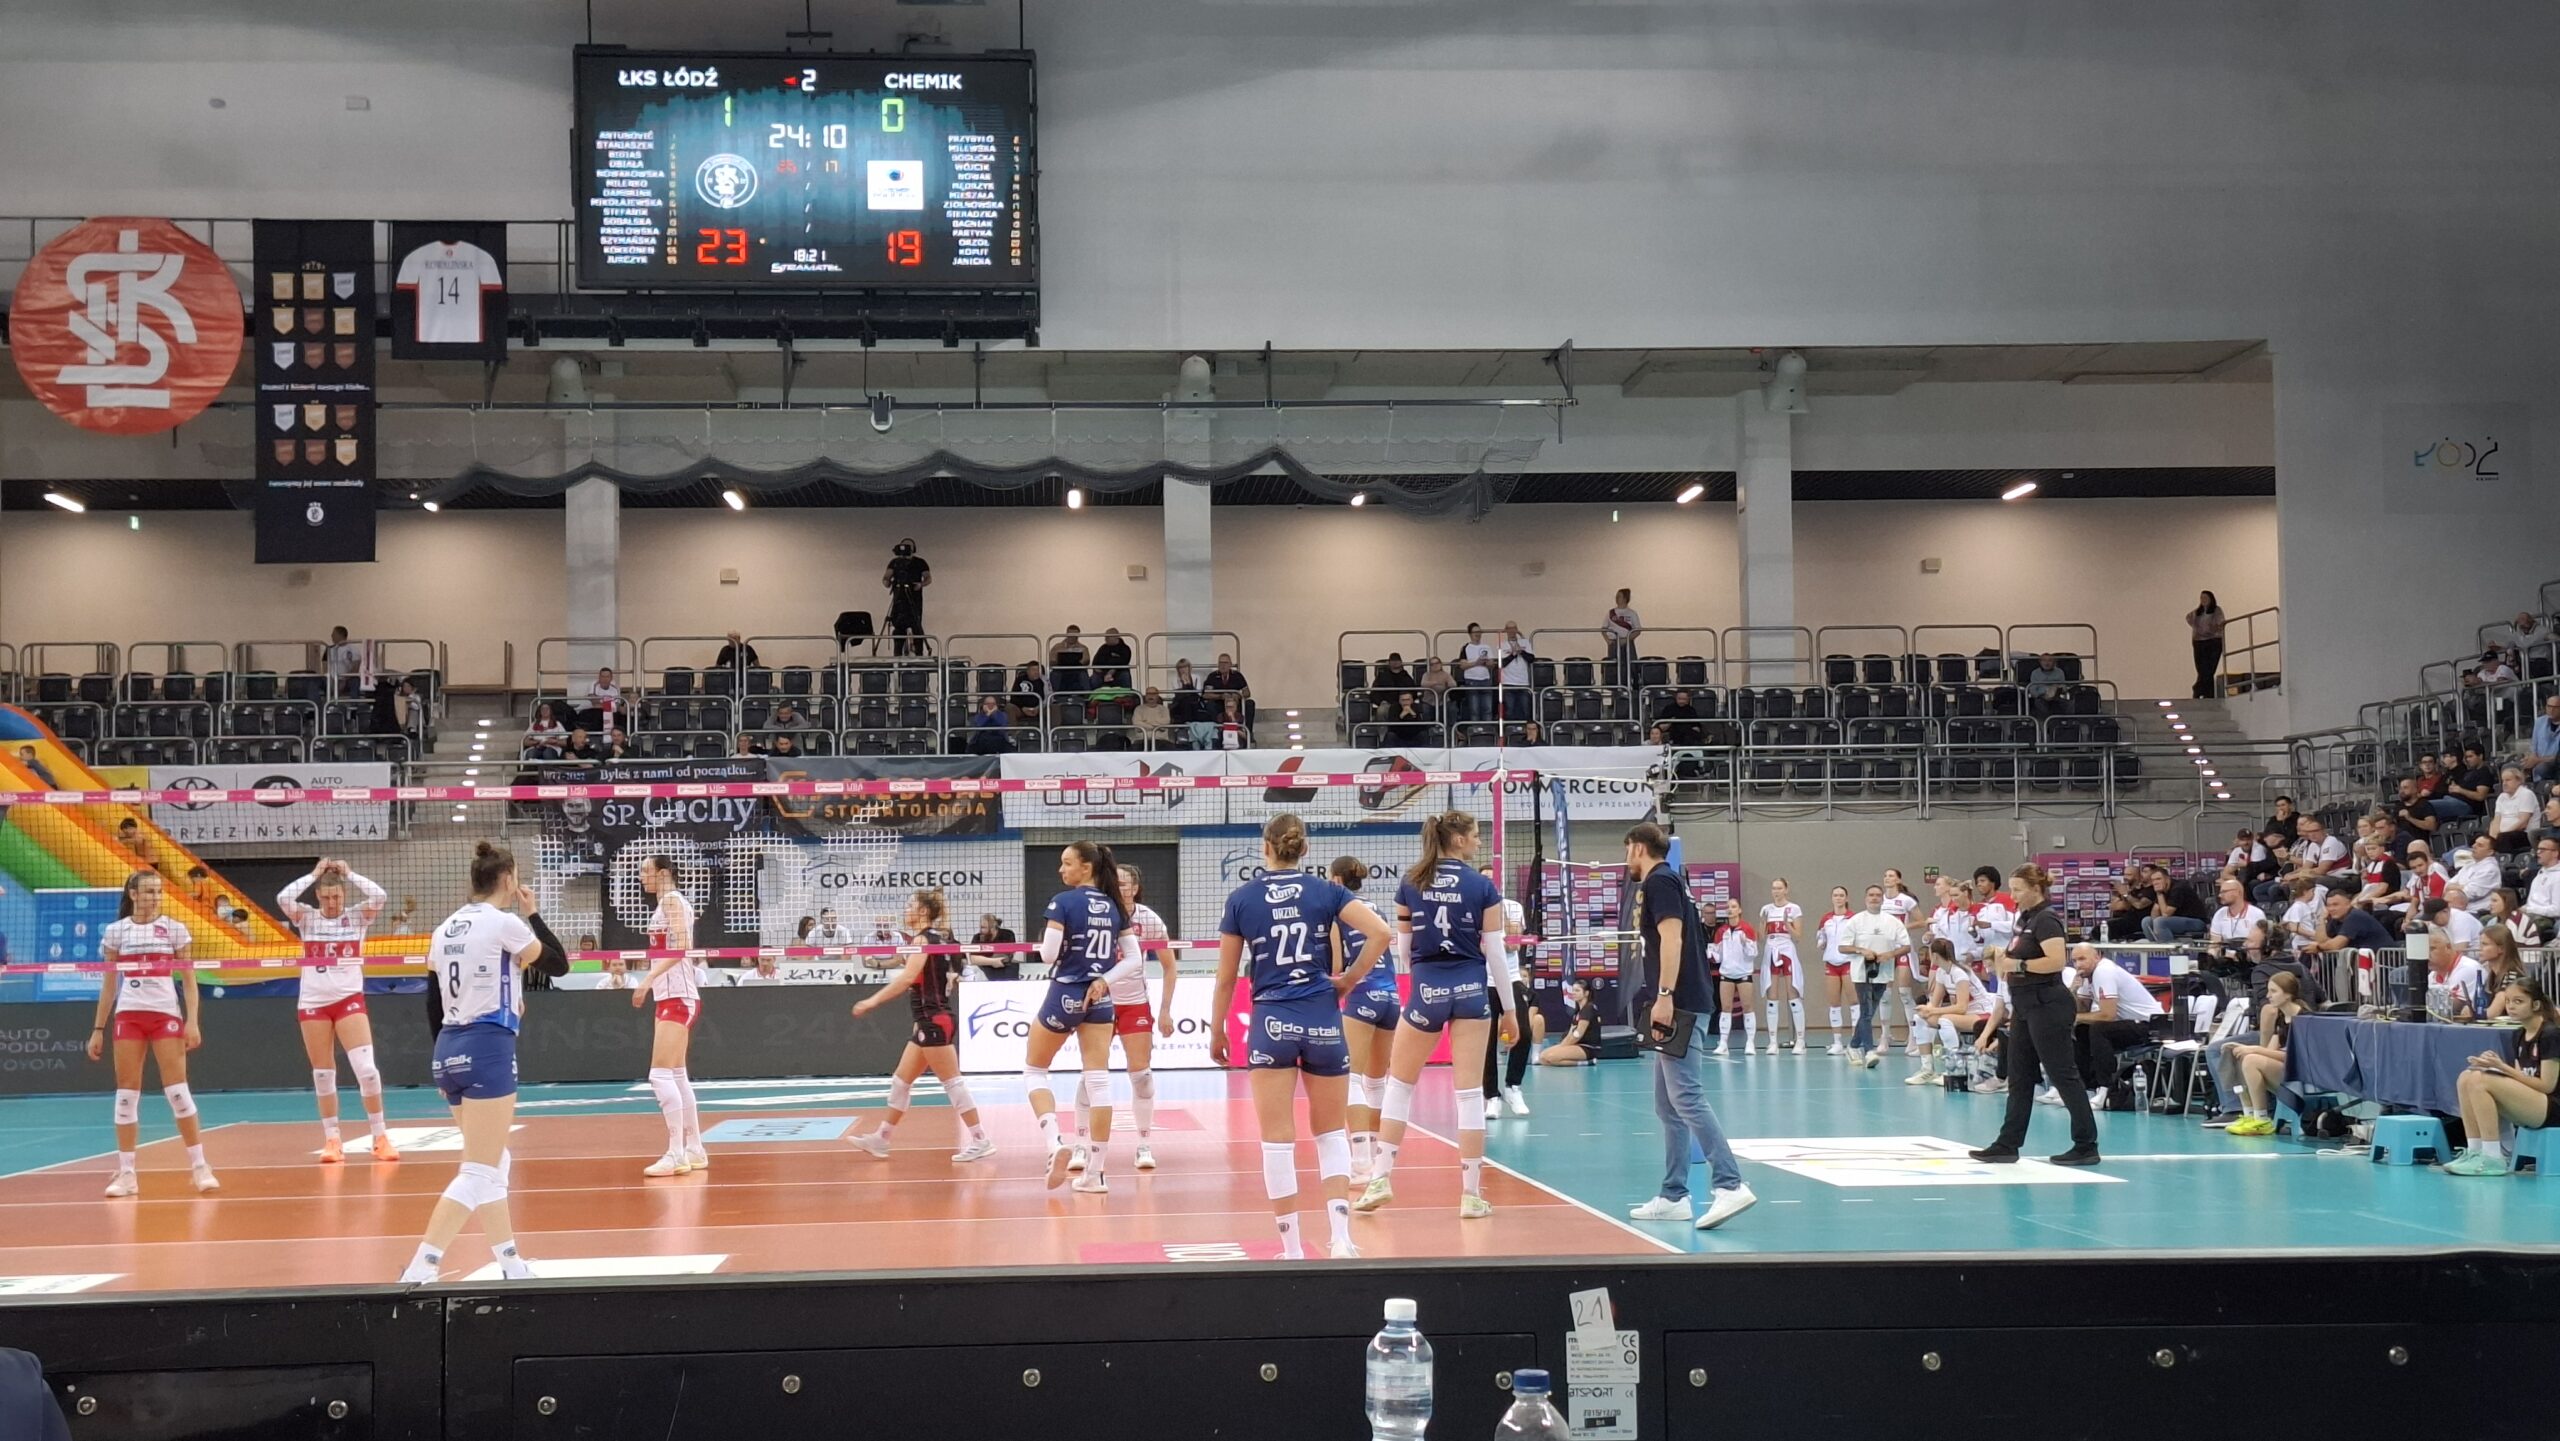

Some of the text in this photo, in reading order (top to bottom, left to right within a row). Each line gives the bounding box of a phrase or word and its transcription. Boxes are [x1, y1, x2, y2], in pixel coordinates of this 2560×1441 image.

[618, 67, 718, 87] ŁKS ŁÓDŹ
[801, 69, 817, 92] 2
[884, 73, 963, 90] CHEMIK
[723, 96, 732, 128] 1
[881, 98, 905, 133] 0
[697, 228, 748, 265] 23
[887, 230, 922, 266] 19
[437, 276, 460, 305] 14
[311, 776, 343, 785] AUTO
[643, 766, 673, 779] nami
[676, 764, 691, 777] od
[601, 798, 642, 827] ŚP.
[336, 823, 379, 837] 24A
[1433, 905, 1452, 938] 4
[1085, 929, 1113, 959] 20
[1270, 921, 1313, 966] 22
[448, 961, 461, 999] 8
[0, 1059, 66, 1071] OYOTA
[1575, 1296, 1604, 1327] 21
[1621, 1334, 1638, 1349] CE
